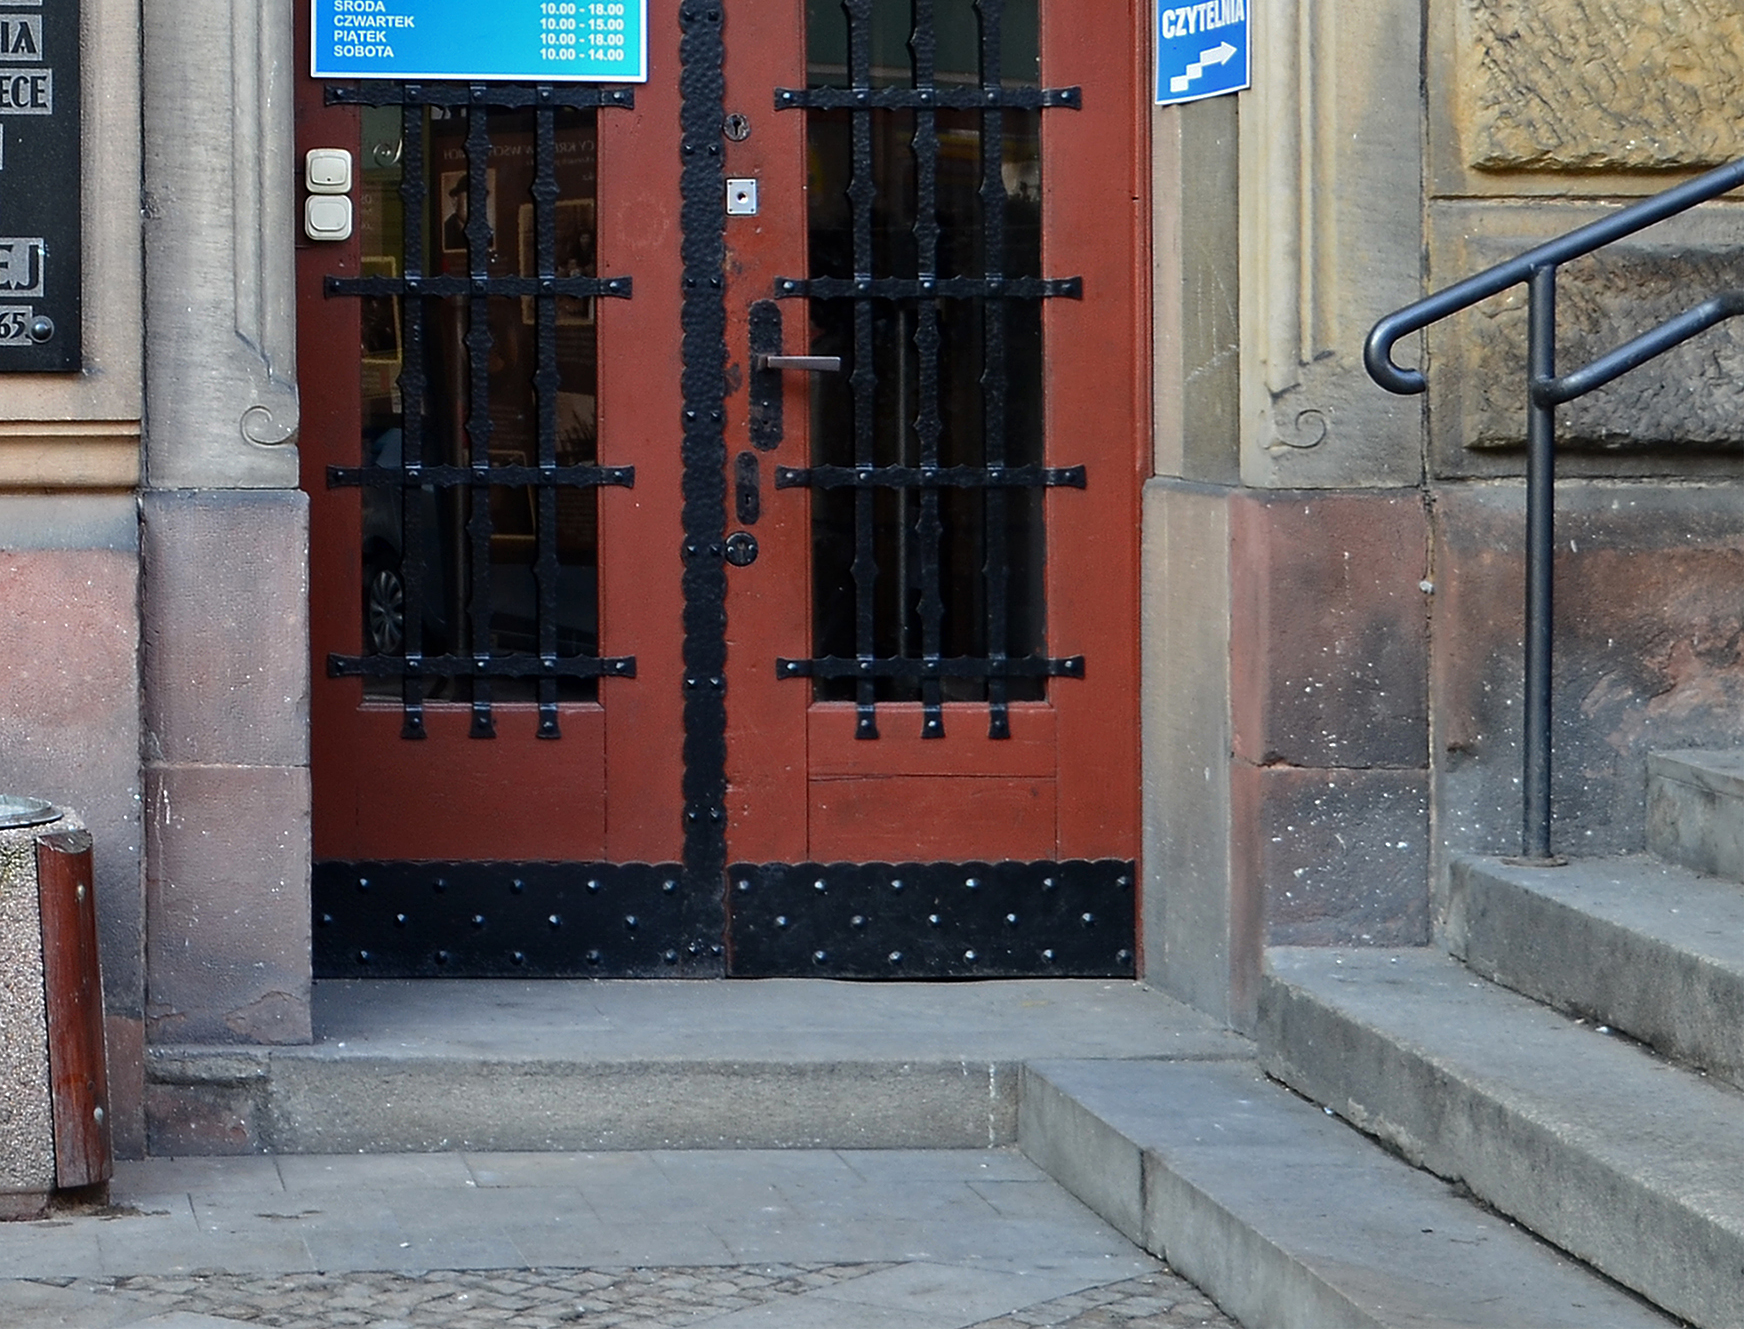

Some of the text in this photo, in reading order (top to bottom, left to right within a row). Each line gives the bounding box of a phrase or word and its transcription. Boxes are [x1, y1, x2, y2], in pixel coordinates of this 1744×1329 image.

[540, 4, 576, 15] 10.00
[588, 4, 624, 16] 18.00
[334, 15, 415, 28] CZWARTEK
[540, 19, 576, 31] 10.00
[588, 19, 624, 31] 15.00
[334, 31, 386, 44] PIĄTEK
[540, 34, 576, 46] 10.00
[588, 34, 624, 46] 18.00
[334, 45, 394, 58] SOBOTA
[540, 49, 576, 61] 10.00
[588, 49, 624, 61] 14.00
